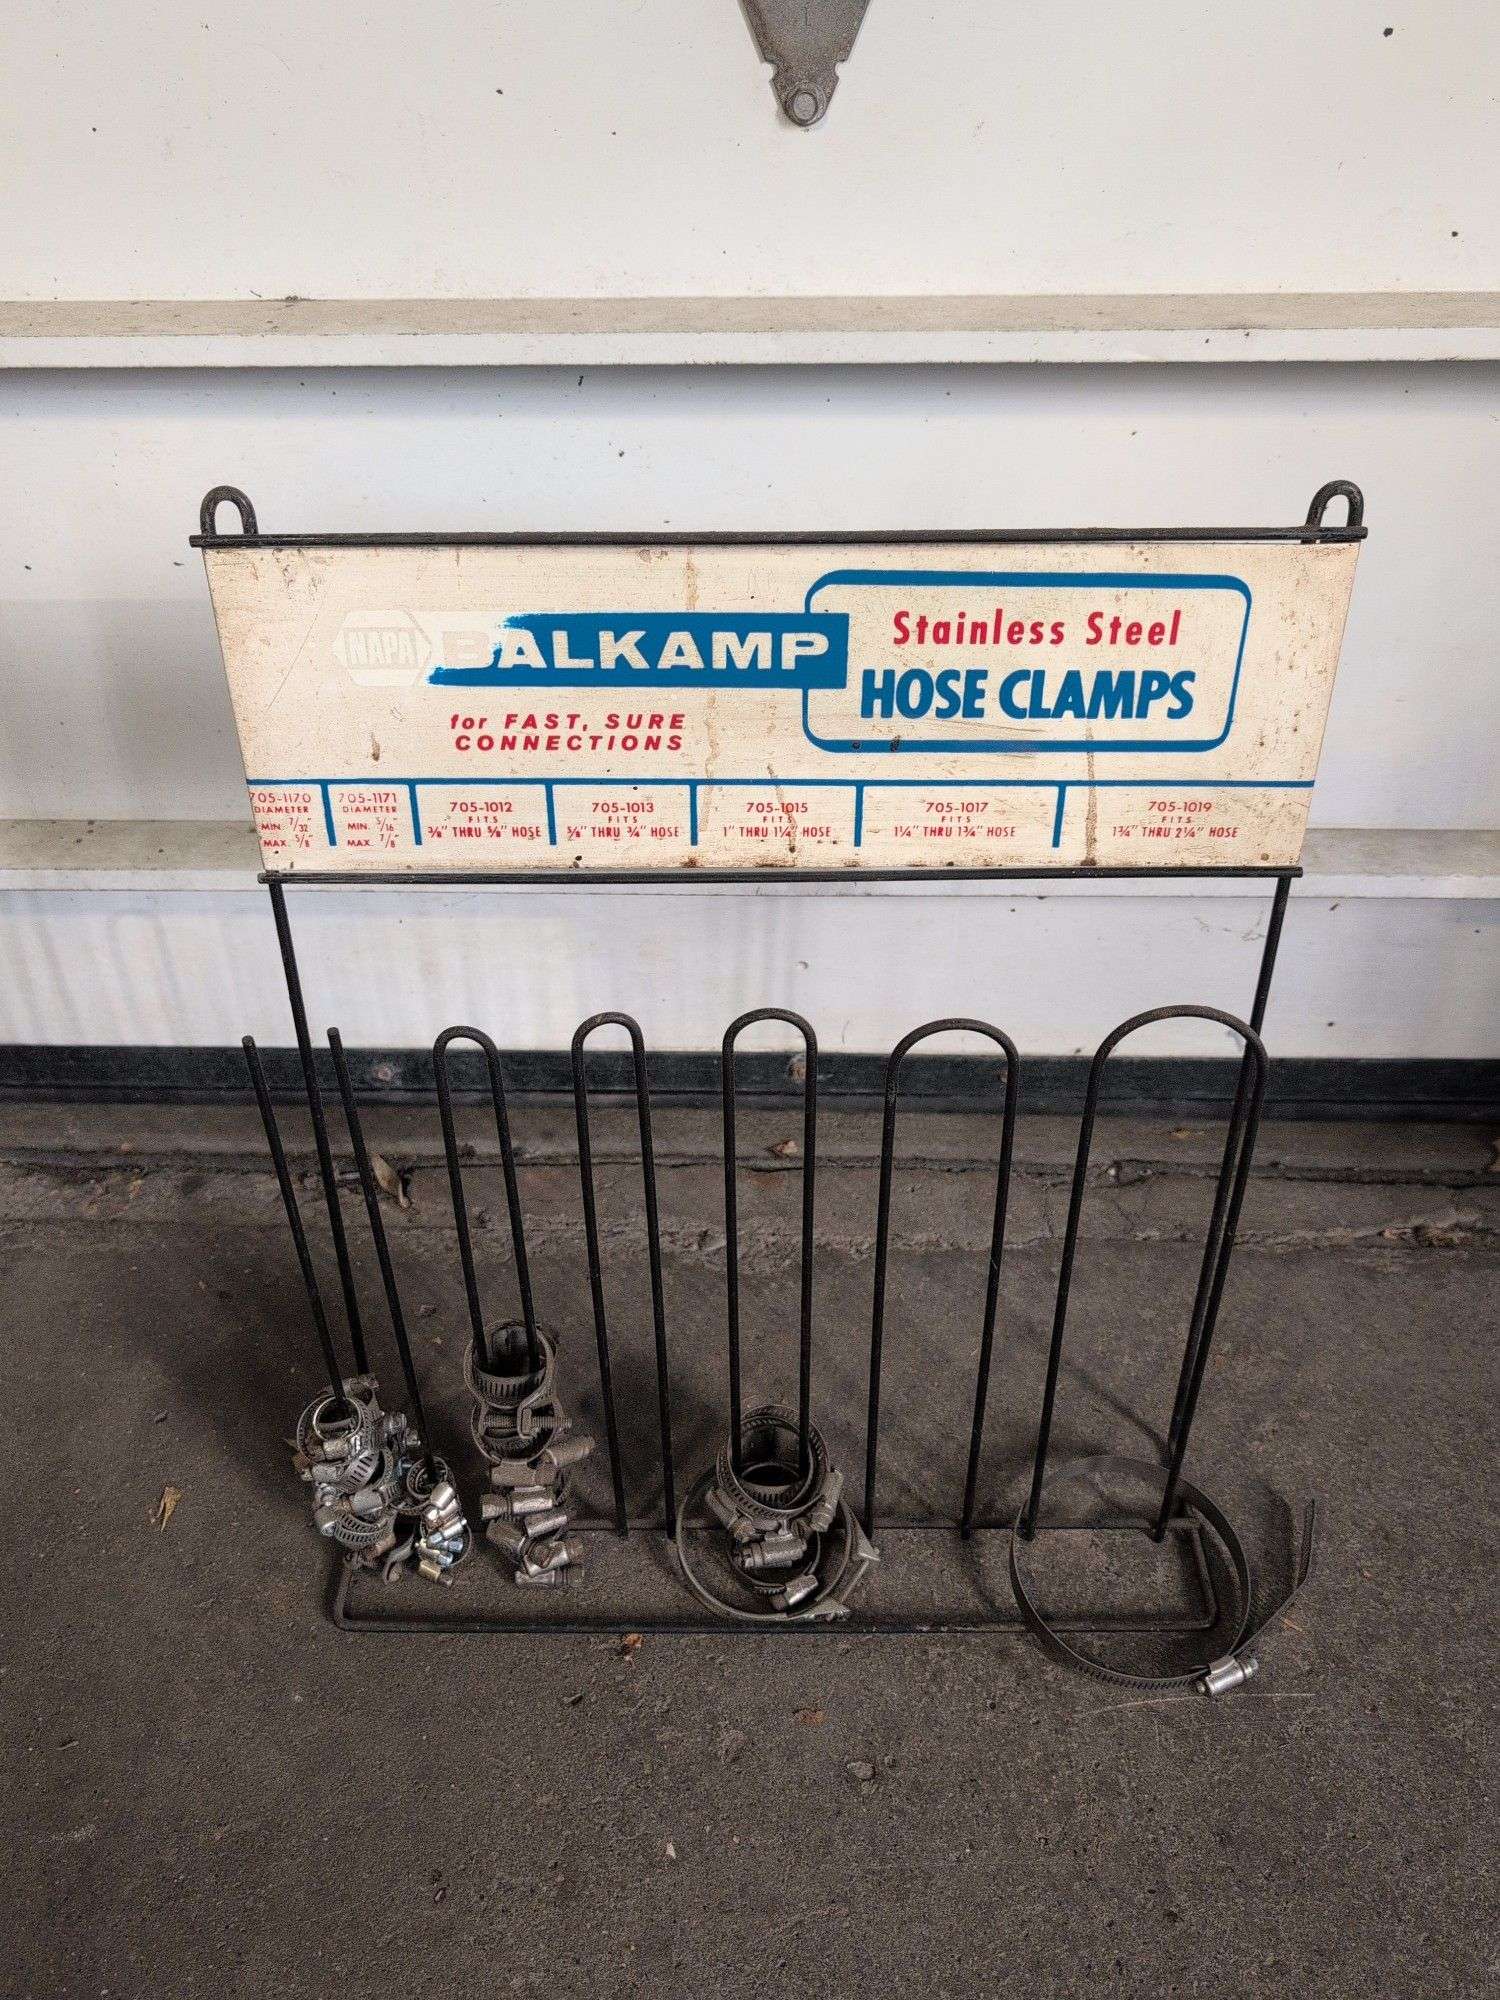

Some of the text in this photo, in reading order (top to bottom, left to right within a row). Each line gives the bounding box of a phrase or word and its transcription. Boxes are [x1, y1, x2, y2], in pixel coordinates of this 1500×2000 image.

[893, 608, 1182, 645] Stainless Steel
[348, 630, 418, 668] NAPA
[442, 630, 830, 671] BALKAMP
[861, 669, 1196, 720] HOSE CLAMPS
[450, 713, 686, 731] for FAST, SURE
[455, 734, 683, 751] CONNECTIONS
[338, 792, 398, 804] 705-1171
[254, 805, 310, 814] DIAMETER
[343, 805, 397, 814] DIAMETER
[450, 801, 514, 813] 705-1012
[592, 801, 655, 813] 705-1013
[746, 802, 808, 813] 705-1015
[925, 802, 989, 813] 705-1017
[1148, 801, 1213, 813] 705-1019
[468, 816, 499, 824] FITS
[608, 816, 638, 824] FITS
[763, 816, 793, 824] FITS
[941, 816, 972, 824] FITS
[1161, 816, 1193, 824] FITS
[453, 826, 482, 838] THRU
[512, 826, 542, 838] HOSE
[592, 826, 621, 838] THRU
[651, 826, 680, 838] HOSE
[739, 826, 769, 838] THRU
[802, 826, 832, 838] HOSE
[924, 826, 954, 838] THRU
[987, 826, 1017, 838] HOSE
[1141, 826, 1171, 838] THRU
[1208, 826, 1240, 838] HOSE
